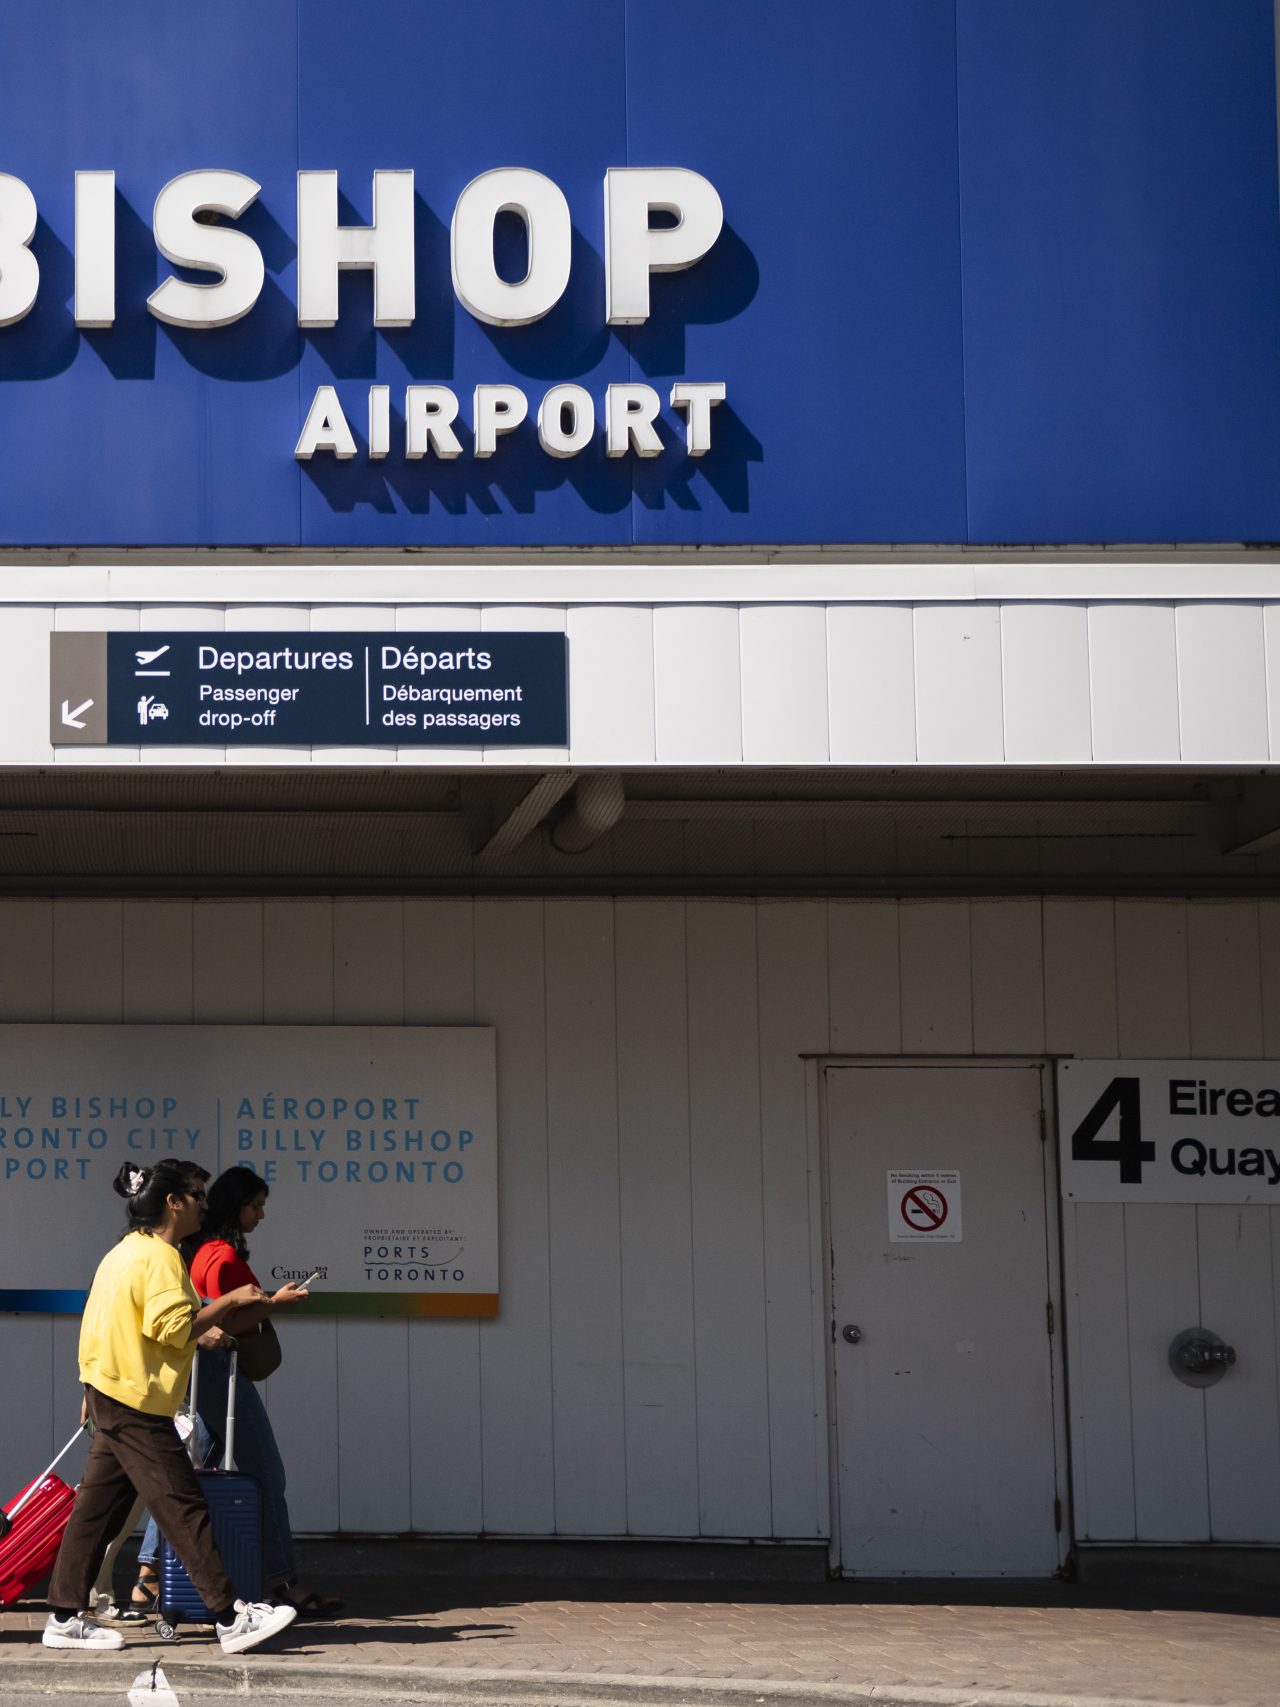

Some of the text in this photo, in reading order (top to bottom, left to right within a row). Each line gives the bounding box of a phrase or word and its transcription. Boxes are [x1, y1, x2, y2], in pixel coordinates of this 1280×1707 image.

[293, 381, 726, 459] AIRPORT
[198, 645, 354, 675] Departures
[381, 645, 492, 674] Départs
[199, 684, 300, 705] Passenger
[382, 684, 523, 705] Débarquement
[198, 709, 277, 730] drop-off
[382, 709, 521, 731] des passagers
[51, 1096, 178, 1119] BISHOP
[236, 1092, 422, 1122] AÉROPORT
[126, 1128, 202, 1151] CITY
[237, 1129, 475, 1153] BILLY BISHOP
[1071, 1077, 1156, 1184] 4
[299, 1160, 465, 1183] TORONTO
[363, 1246, 430, 1259] PORTS
[364, 1268, 465, 1282] TORONTO
